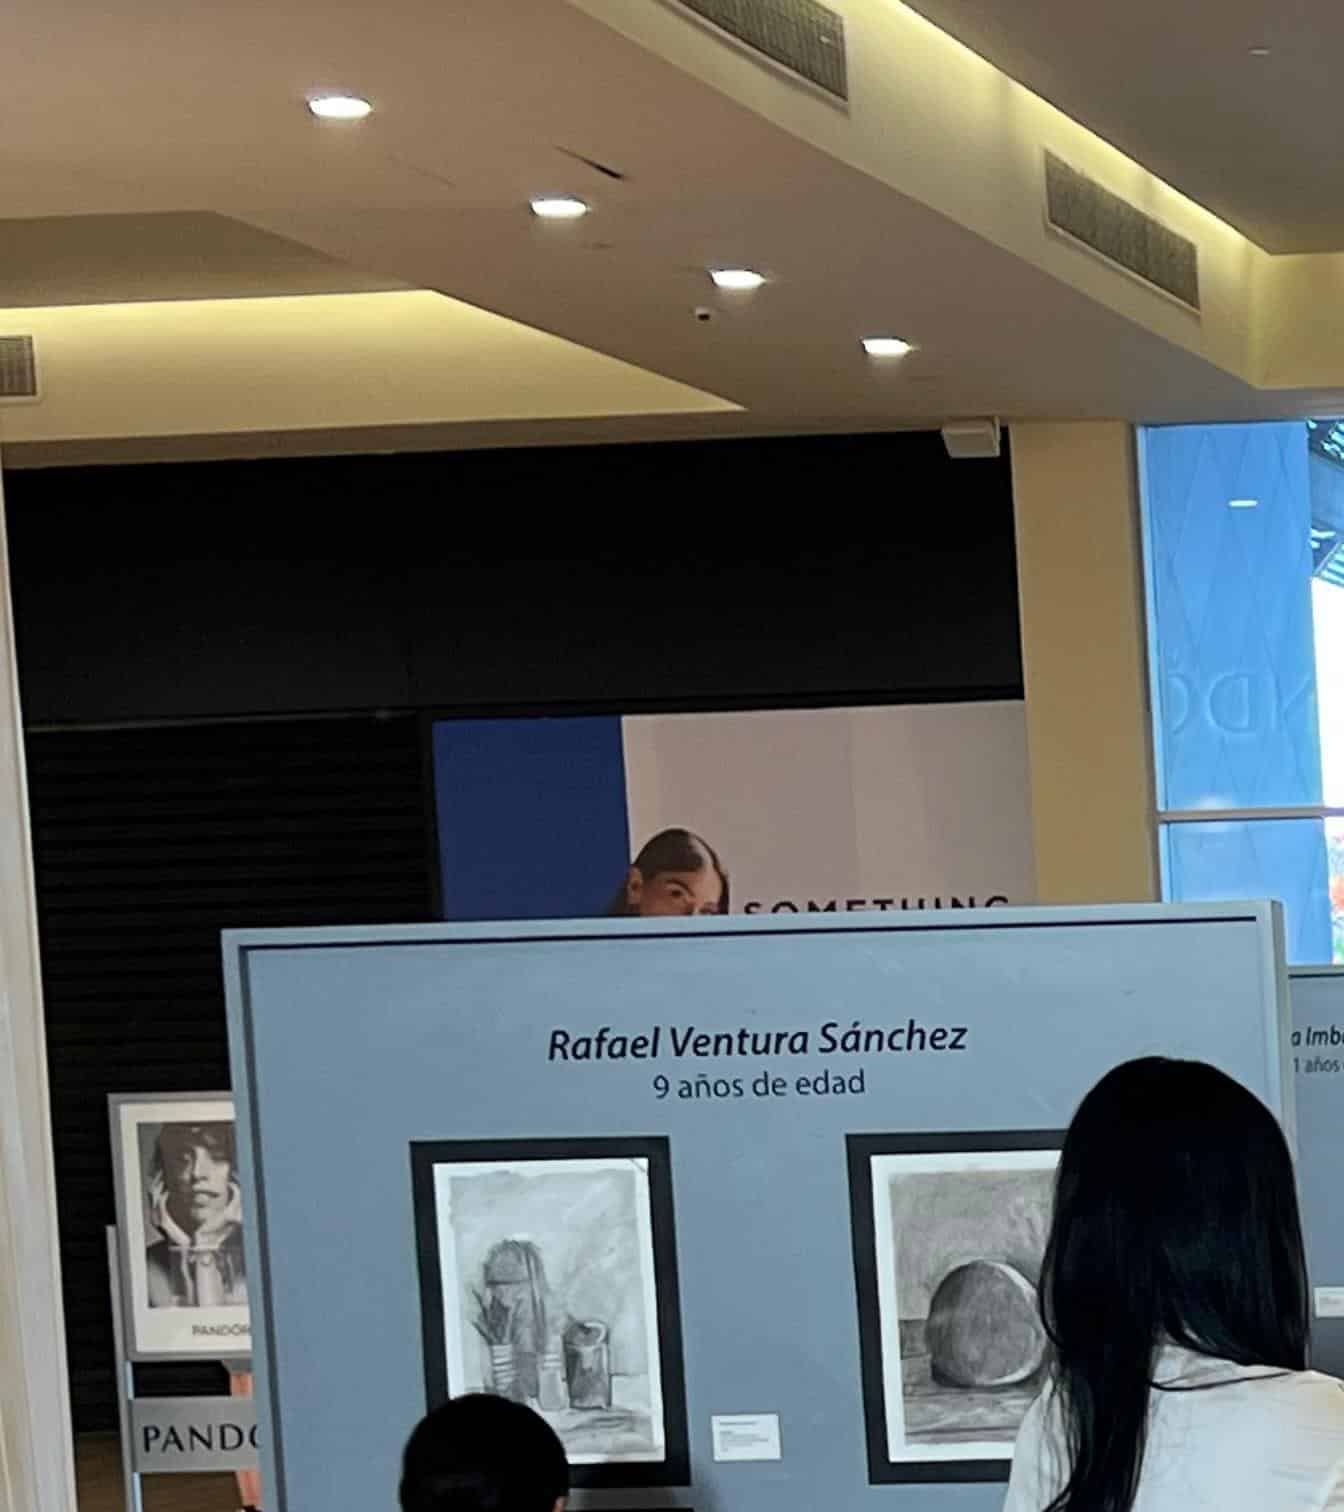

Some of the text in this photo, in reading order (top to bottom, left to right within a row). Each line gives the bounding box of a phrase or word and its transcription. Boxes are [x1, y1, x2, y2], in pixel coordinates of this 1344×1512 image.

[548, 1018, 969, 1062] Rafael Ventura Sánchez
[1304, 1056, 1340, 1073] años
[652, 1068, 866, 1100] 9 años de edad
